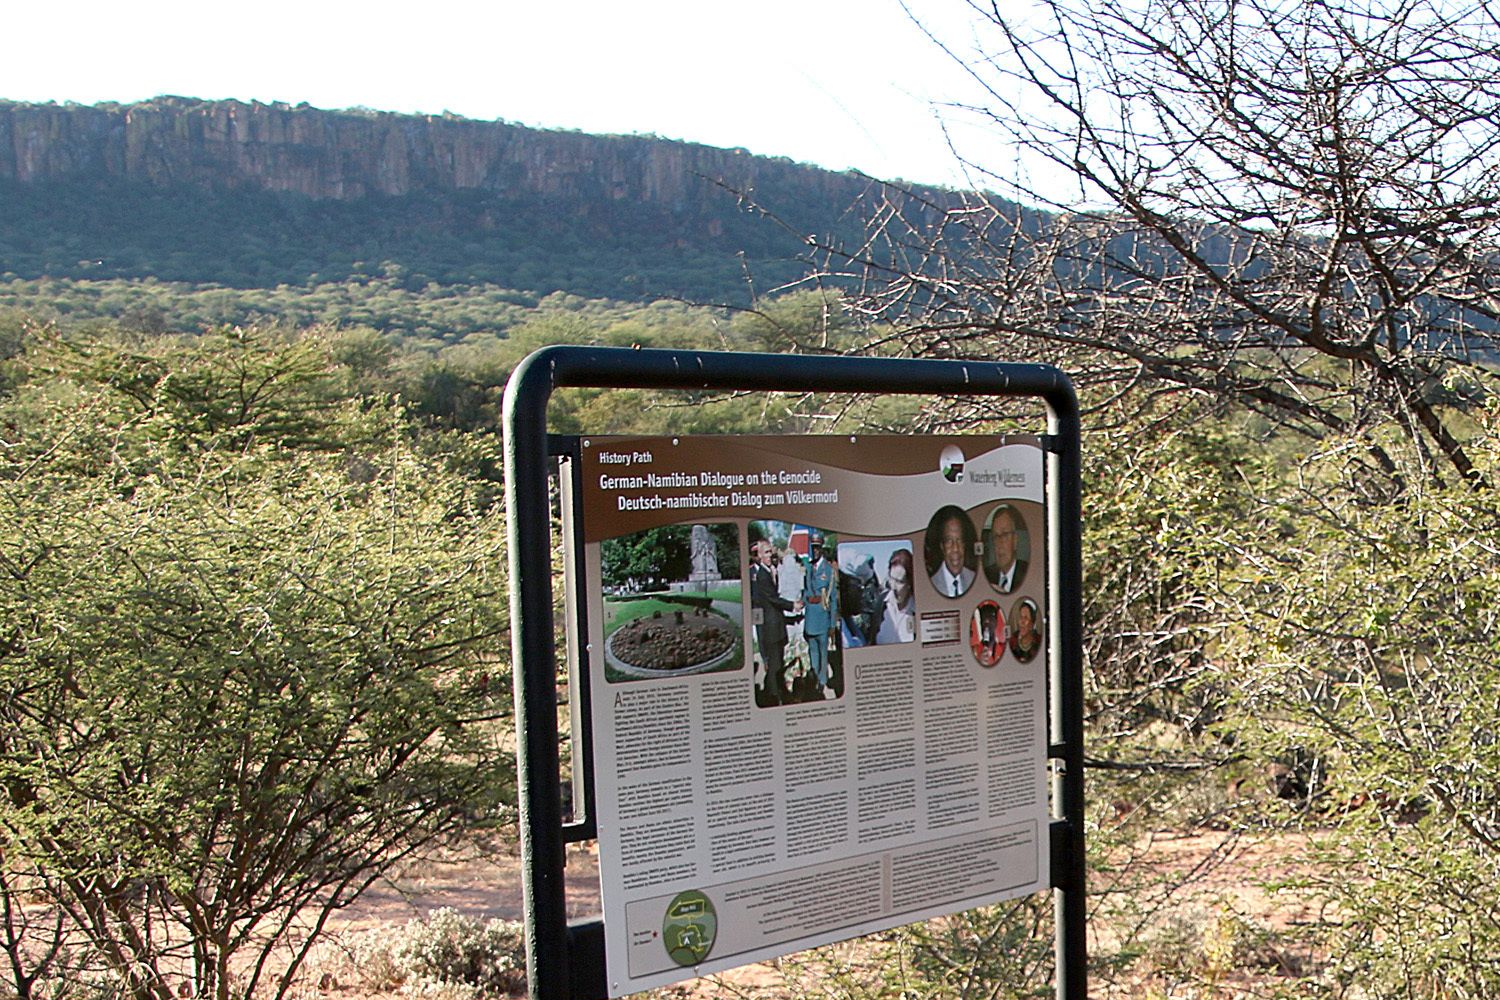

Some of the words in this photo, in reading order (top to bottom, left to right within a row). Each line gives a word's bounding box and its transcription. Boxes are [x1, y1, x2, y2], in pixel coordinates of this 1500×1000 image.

[599, 452, 632, 466] History
[633, 451, 653, 463] Path
[599, 473, 698, 490] German-Namibian
[700, 470, 745, 489] Dialogue
[746, 474, 759, 485] on
[760, 471, 777, 485] the
[778, 469, 822, 485] Genocide
[618, 492, 730, 511] Deutsch-namibischer
[731, 491, 762, 509] Dialog
[764, 494, 784, 505] zum
[786, 489, 839, 504] Völkermord
